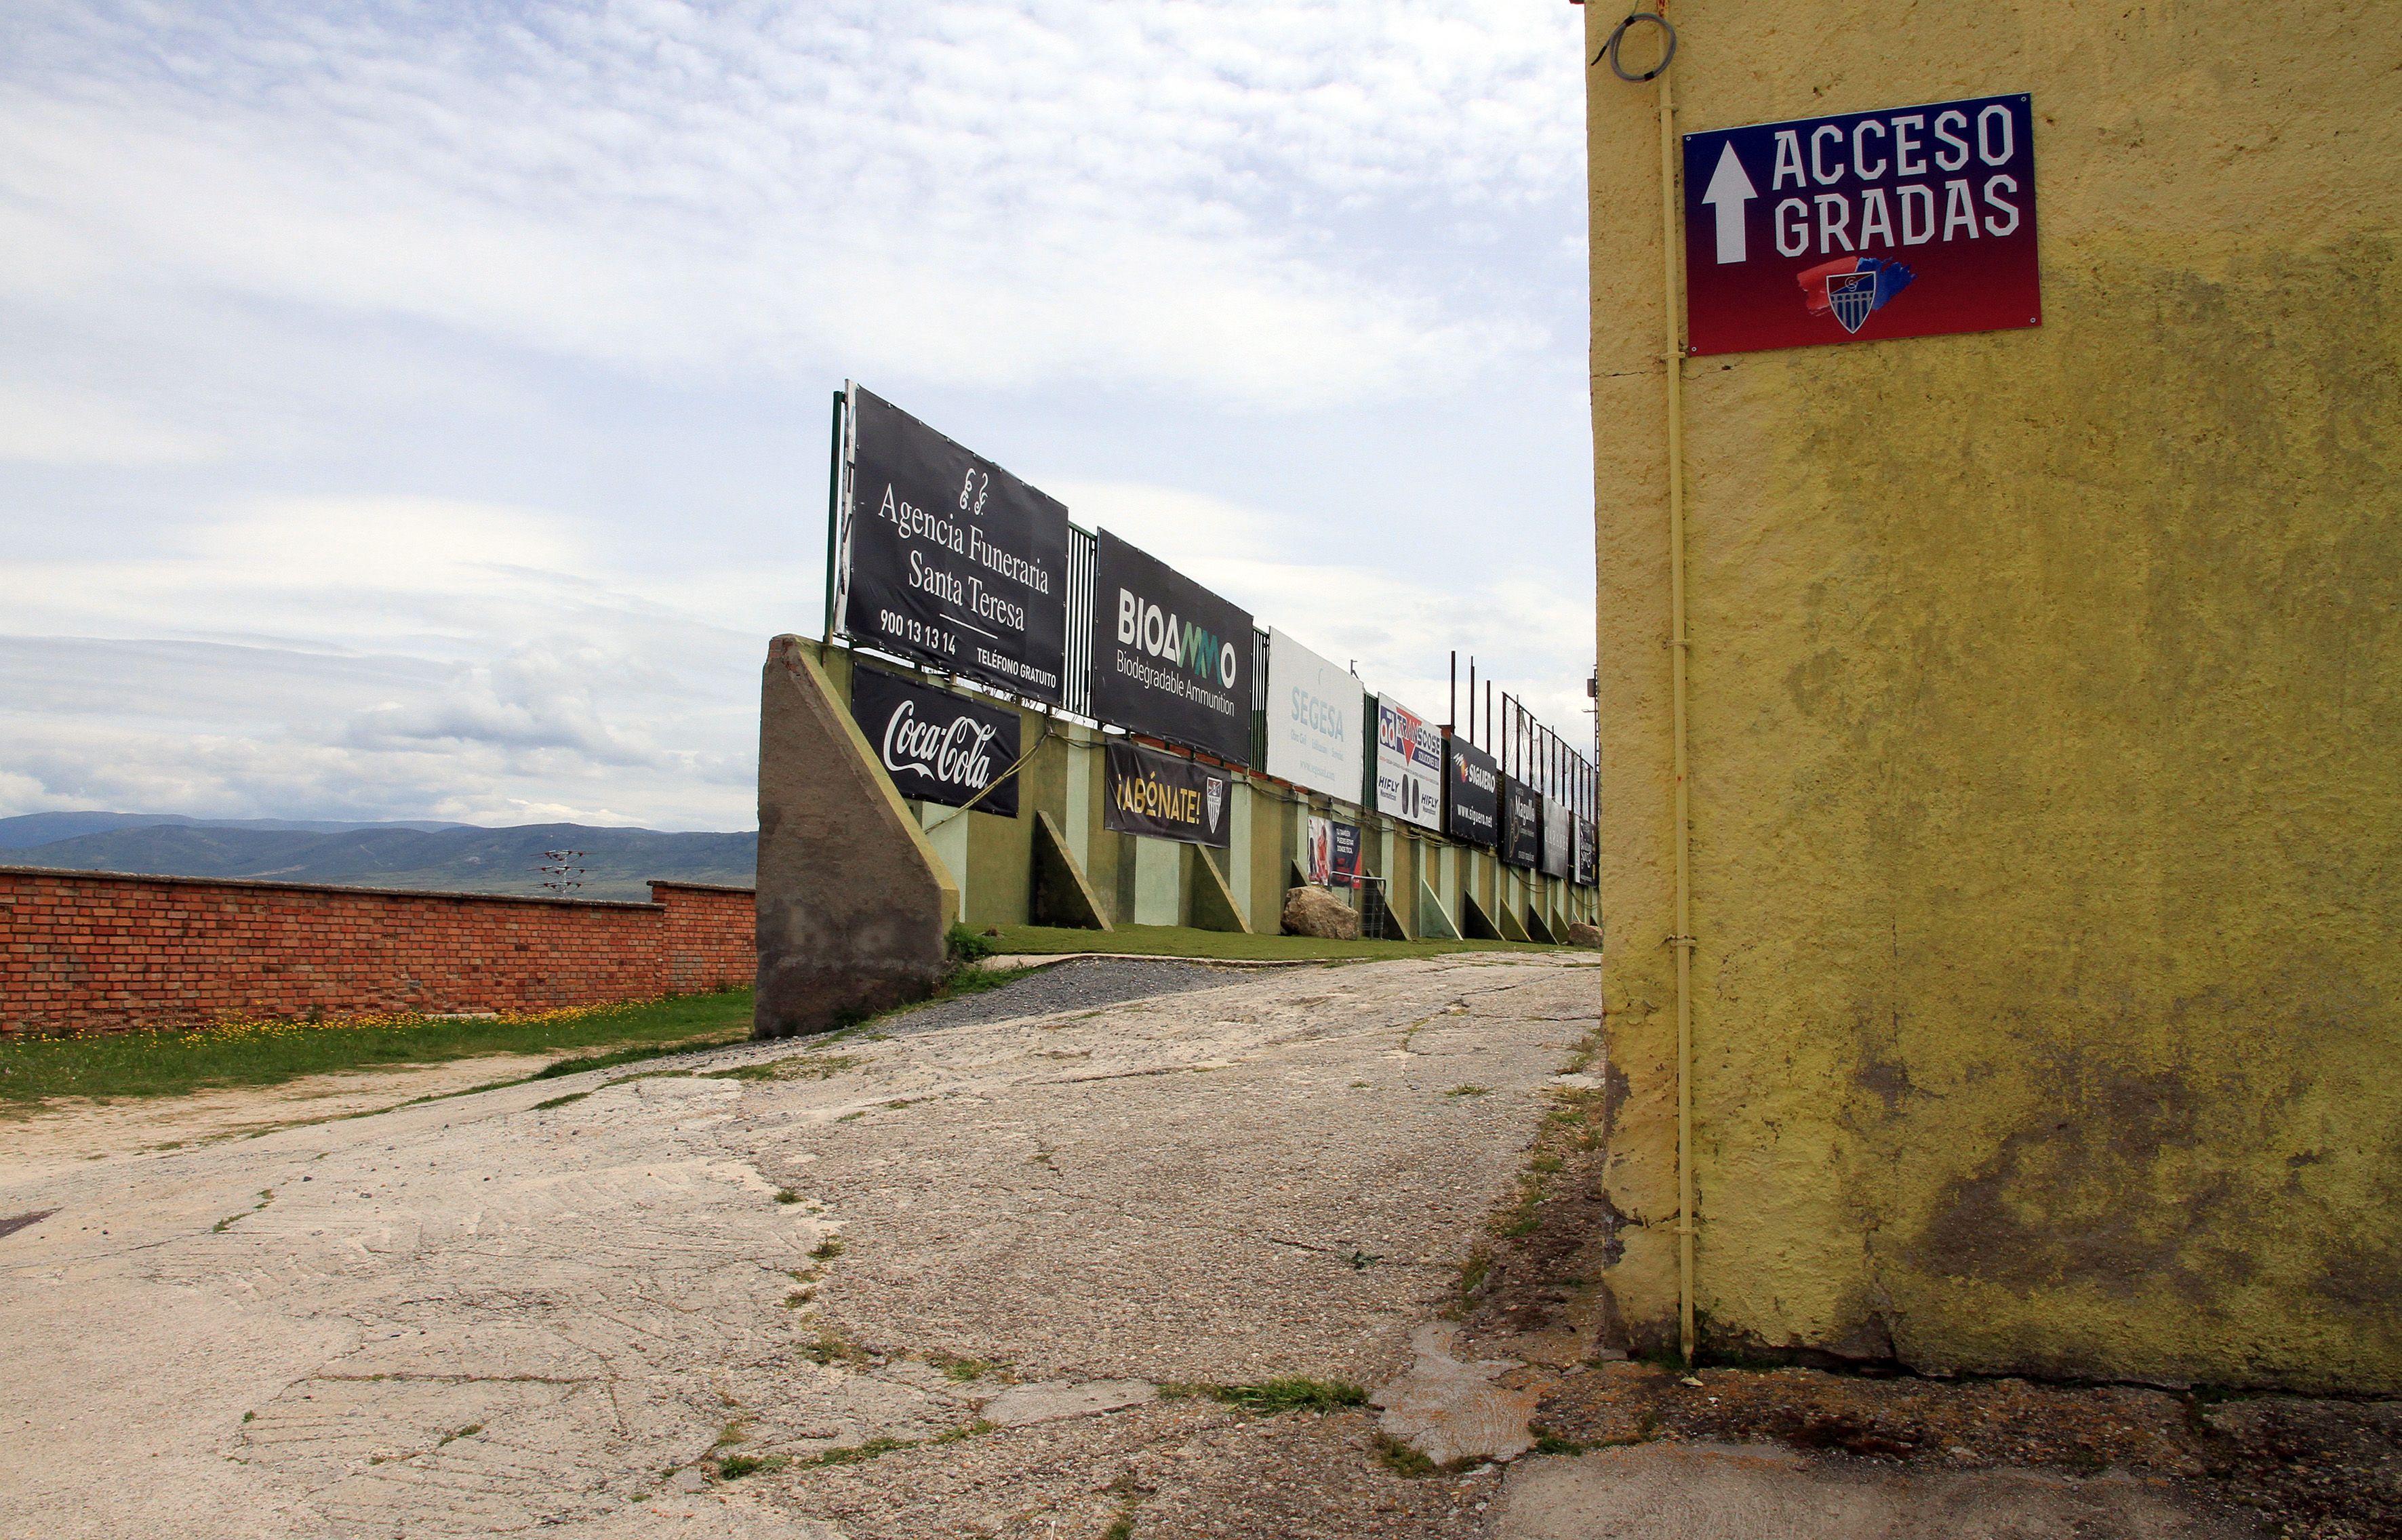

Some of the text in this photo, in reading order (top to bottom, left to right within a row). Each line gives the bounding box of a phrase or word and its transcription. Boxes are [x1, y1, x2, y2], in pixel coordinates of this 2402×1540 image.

[1772, 104, 2014, 191] ACCESO
[1775, 174, 2019, 258] GRADAS
[878, 483, 963, 554] Agencia
[968, 524, 1049, 594] Funeraria
[909, 550, 1024, 631] Santa Teresa
[881, 609, 956, 655] 900 13 13 14
[1118, 587, 1236, 689] BIOAMMO
[977, 647, 1056, 689] TELÉFONO GRATUITO
[1117, 649, 1235, 717] Biodegradable Ammunition
[1292, 686, 1344, 742] SEGESA
[1397, 714, 1440, 755] TRANSCOSE
[883, 700, 997, 790] Coca-Cola
[1117, 771, 1201, 824] ¡ABÓNATE!
[1378, 775, 1399, 793] HIFLY
[1421, 793, 1439, 808] HIFLY
[1468, 763, 1496, 793] SIGUERO
[1457, 804, 1493, 828] www.siguero.net
